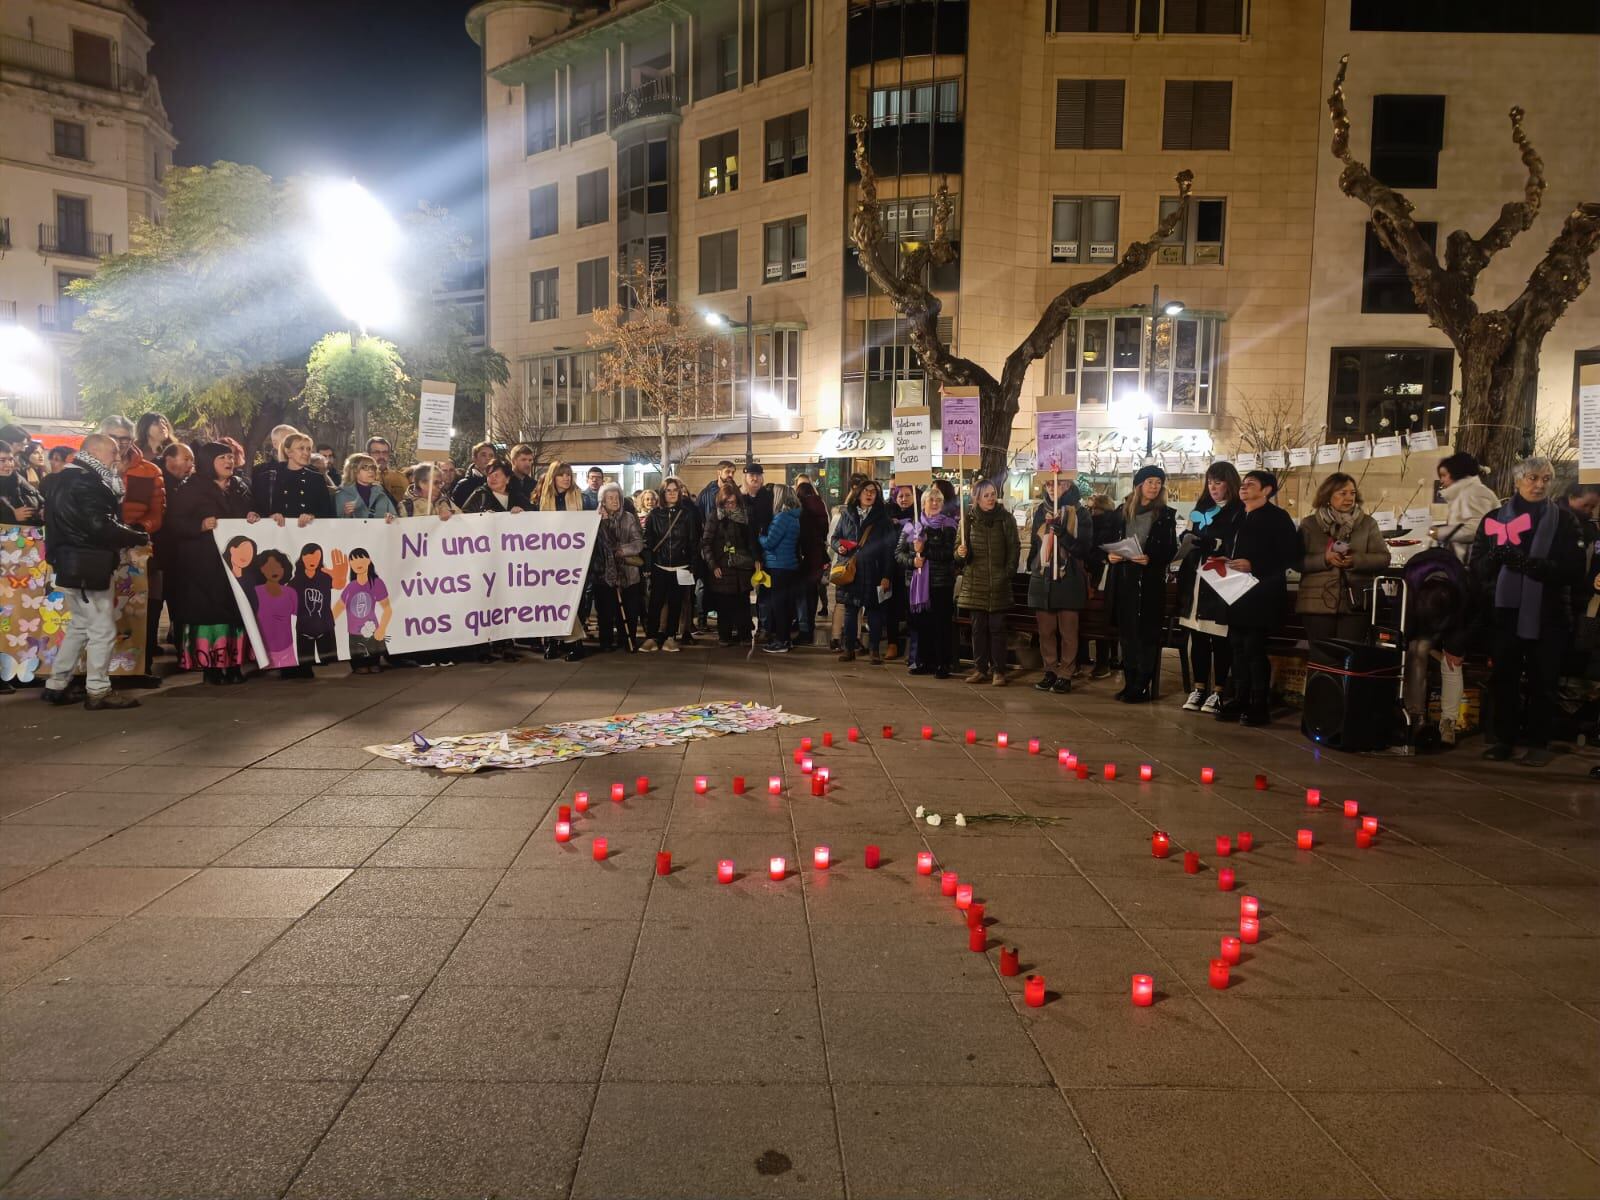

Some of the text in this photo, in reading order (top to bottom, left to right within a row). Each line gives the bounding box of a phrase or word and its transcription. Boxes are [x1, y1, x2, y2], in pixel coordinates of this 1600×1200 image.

[836, 430, 885, 451] Bar
[900, 452, 919, 464] Gaza
[401, 532, 586, 559] Ni una menos
[400, 562, 583, 598] vivas y libres
[404, 613, 452, 637] nos
